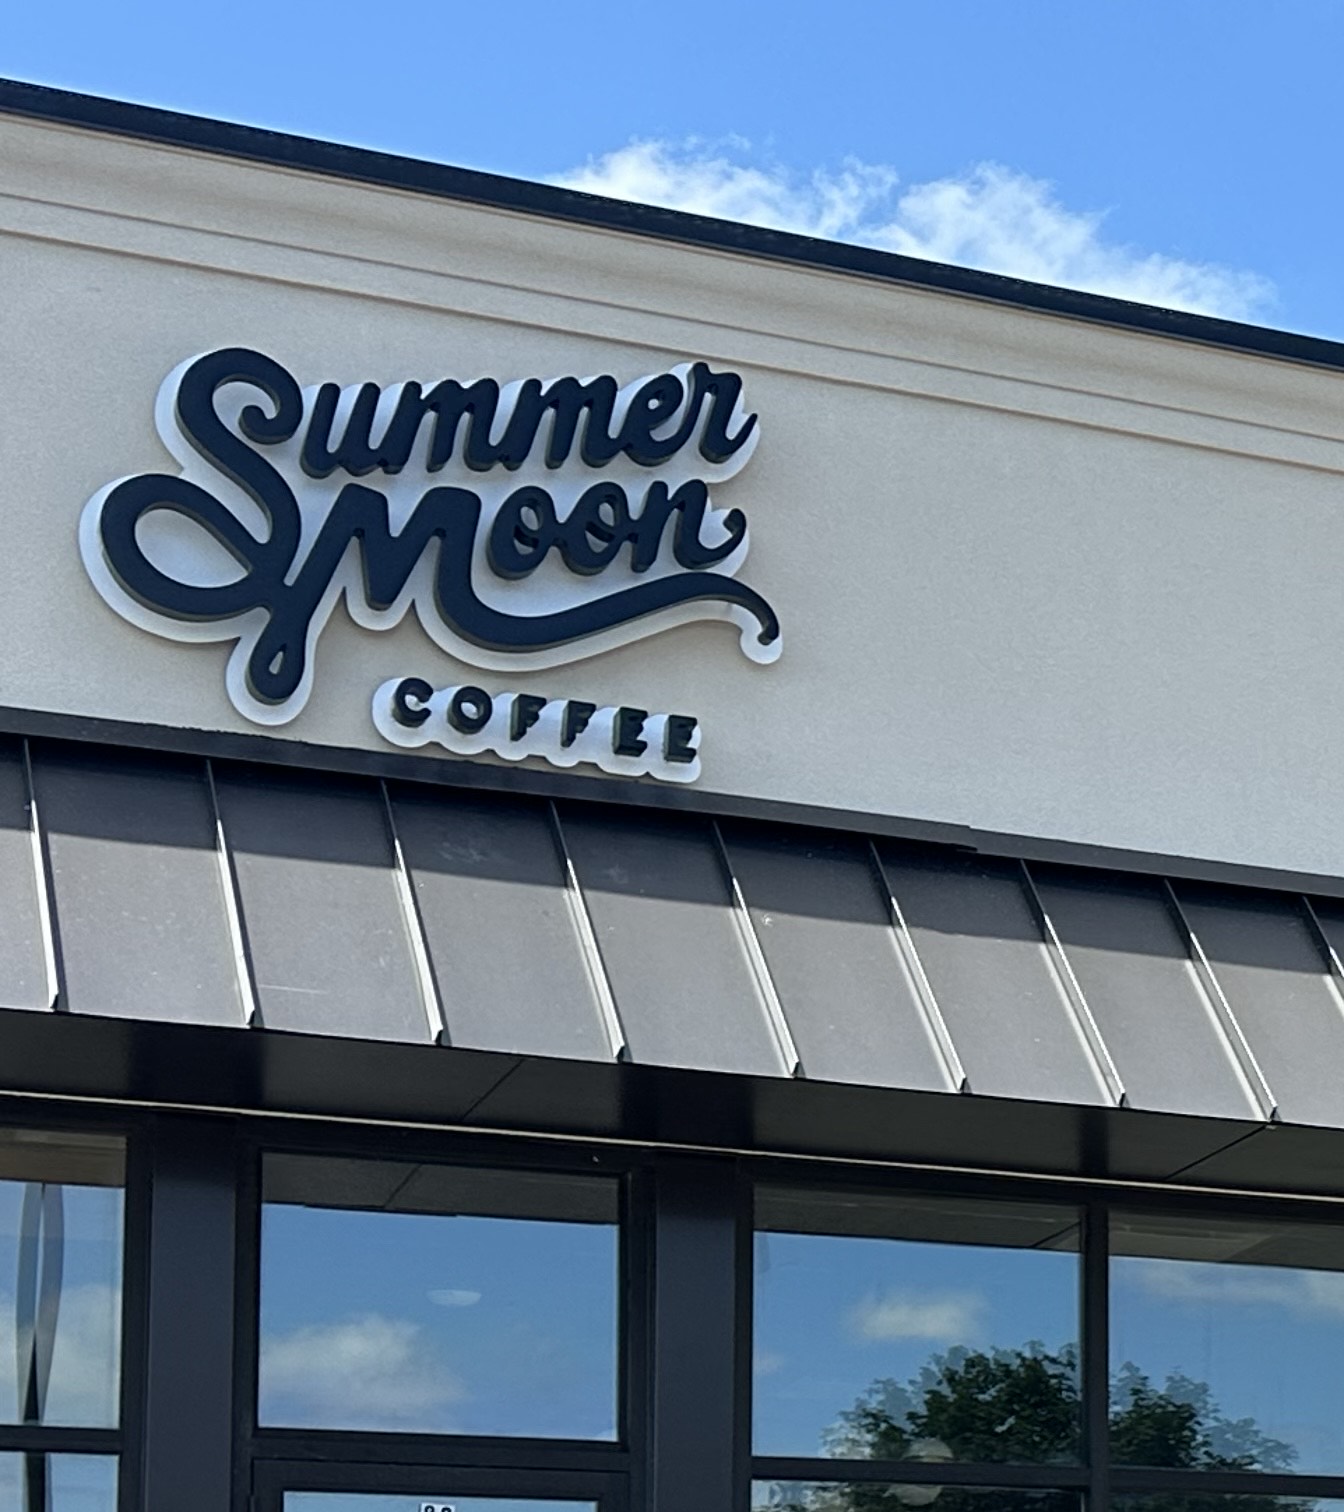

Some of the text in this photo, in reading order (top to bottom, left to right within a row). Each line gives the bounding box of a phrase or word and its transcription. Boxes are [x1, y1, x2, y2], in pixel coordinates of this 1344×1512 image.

[101, 347, 758, 622] Summer
[245, 479, 781, 704] Moon
[392, 677, 699, 764] COFFEE
